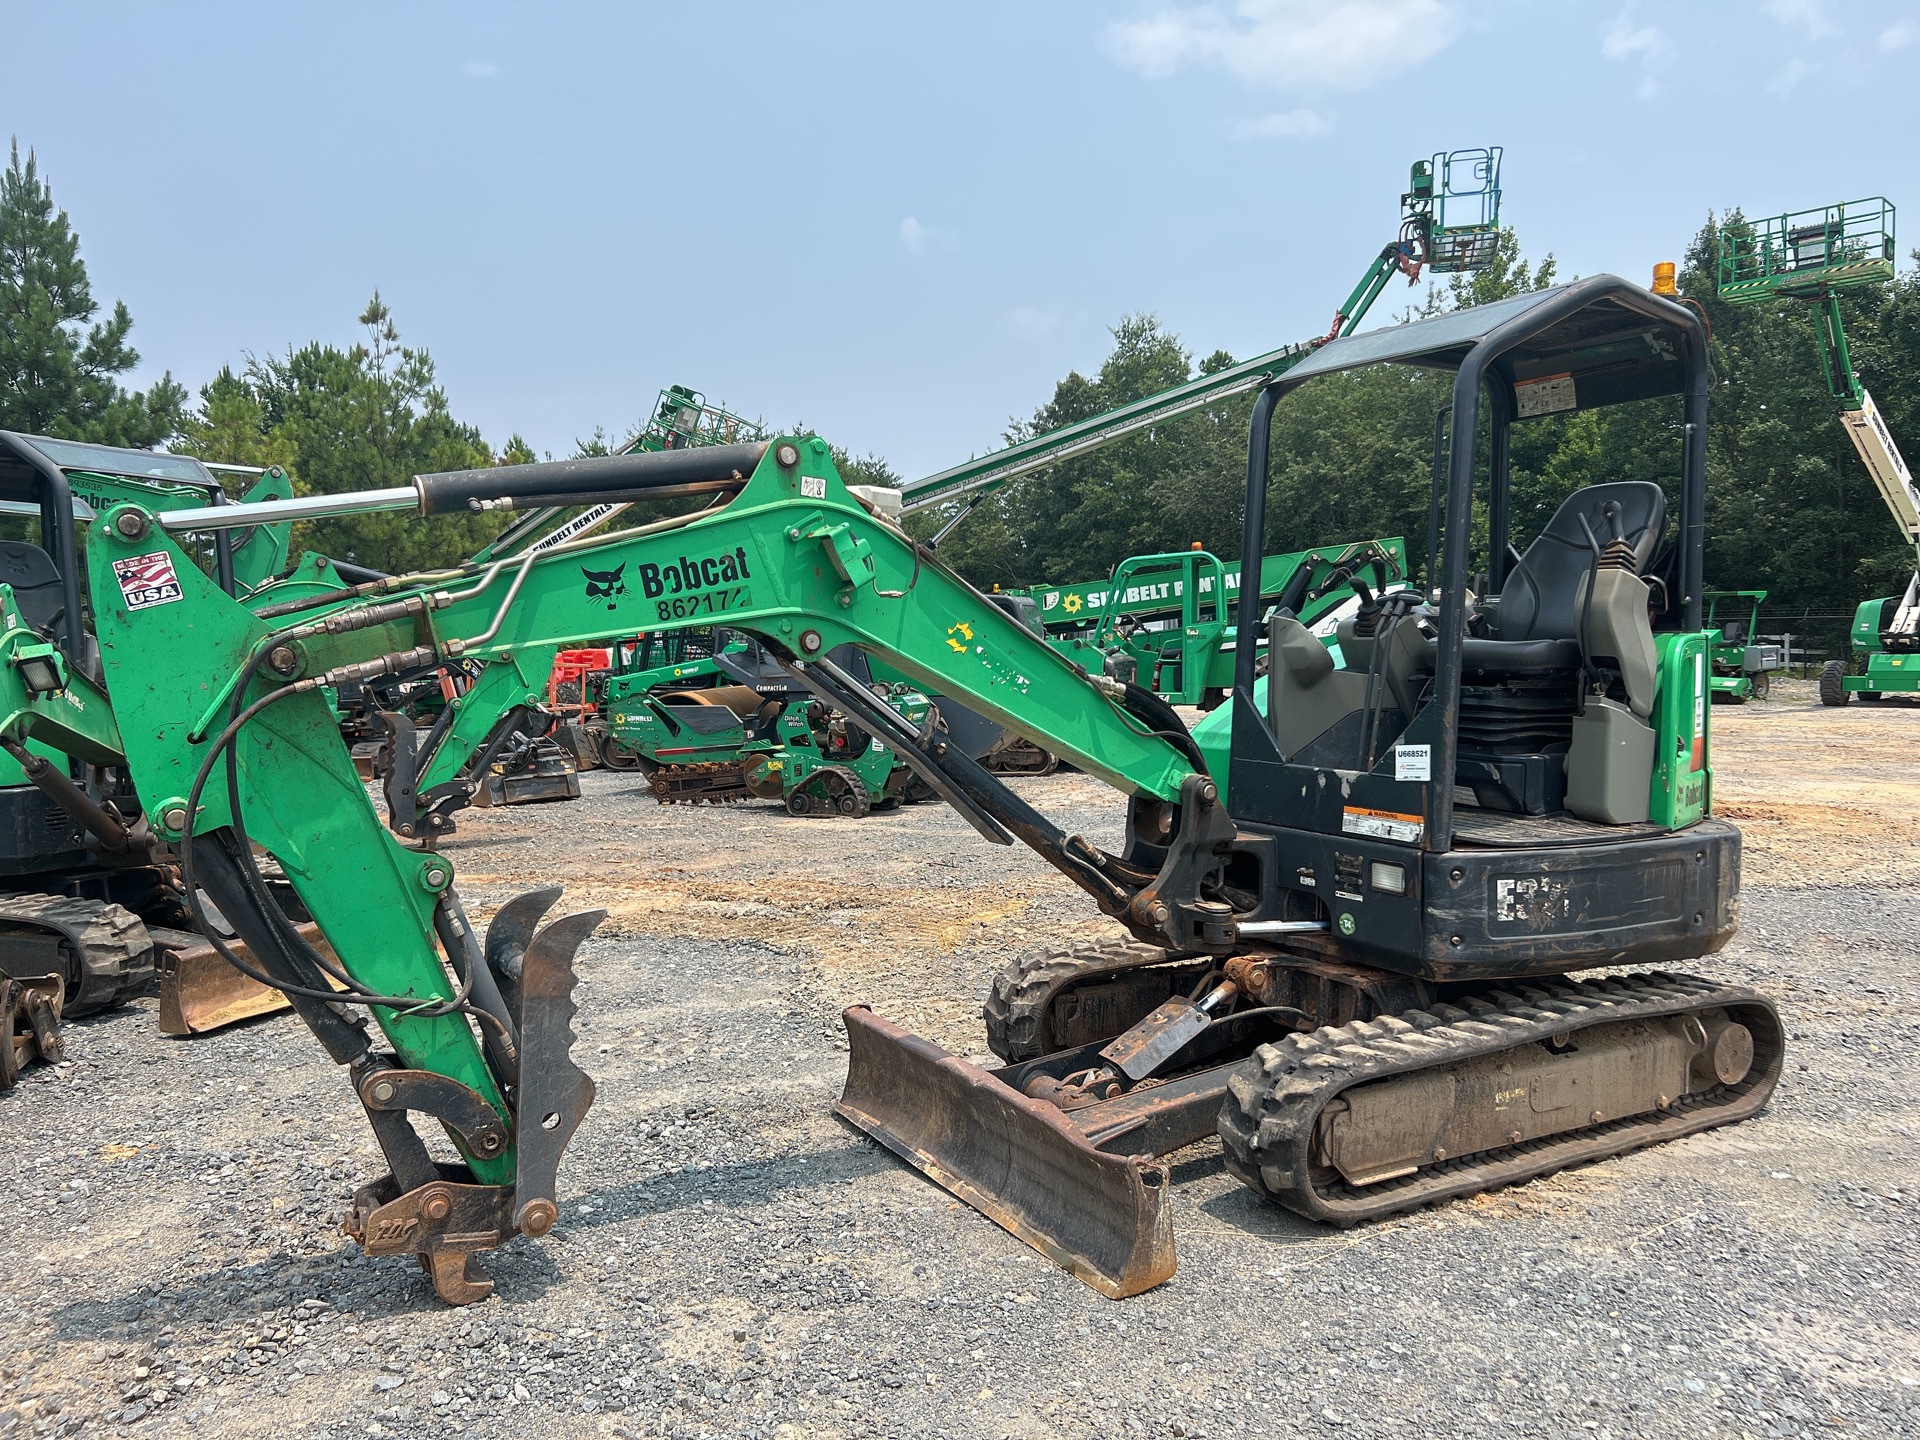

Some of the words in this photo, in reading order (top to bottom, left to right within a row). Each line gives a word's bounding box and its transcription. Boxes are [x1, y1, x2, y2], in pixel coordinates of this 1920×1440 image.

[571, 503, 613, 532] RENTALS
[638, 547, 751, 600] Bobcat
[127, 585, 178, 606] USA
[1397, 750, 1428, 758] U668521
[1373, 811, 1398, 819] WARNING
